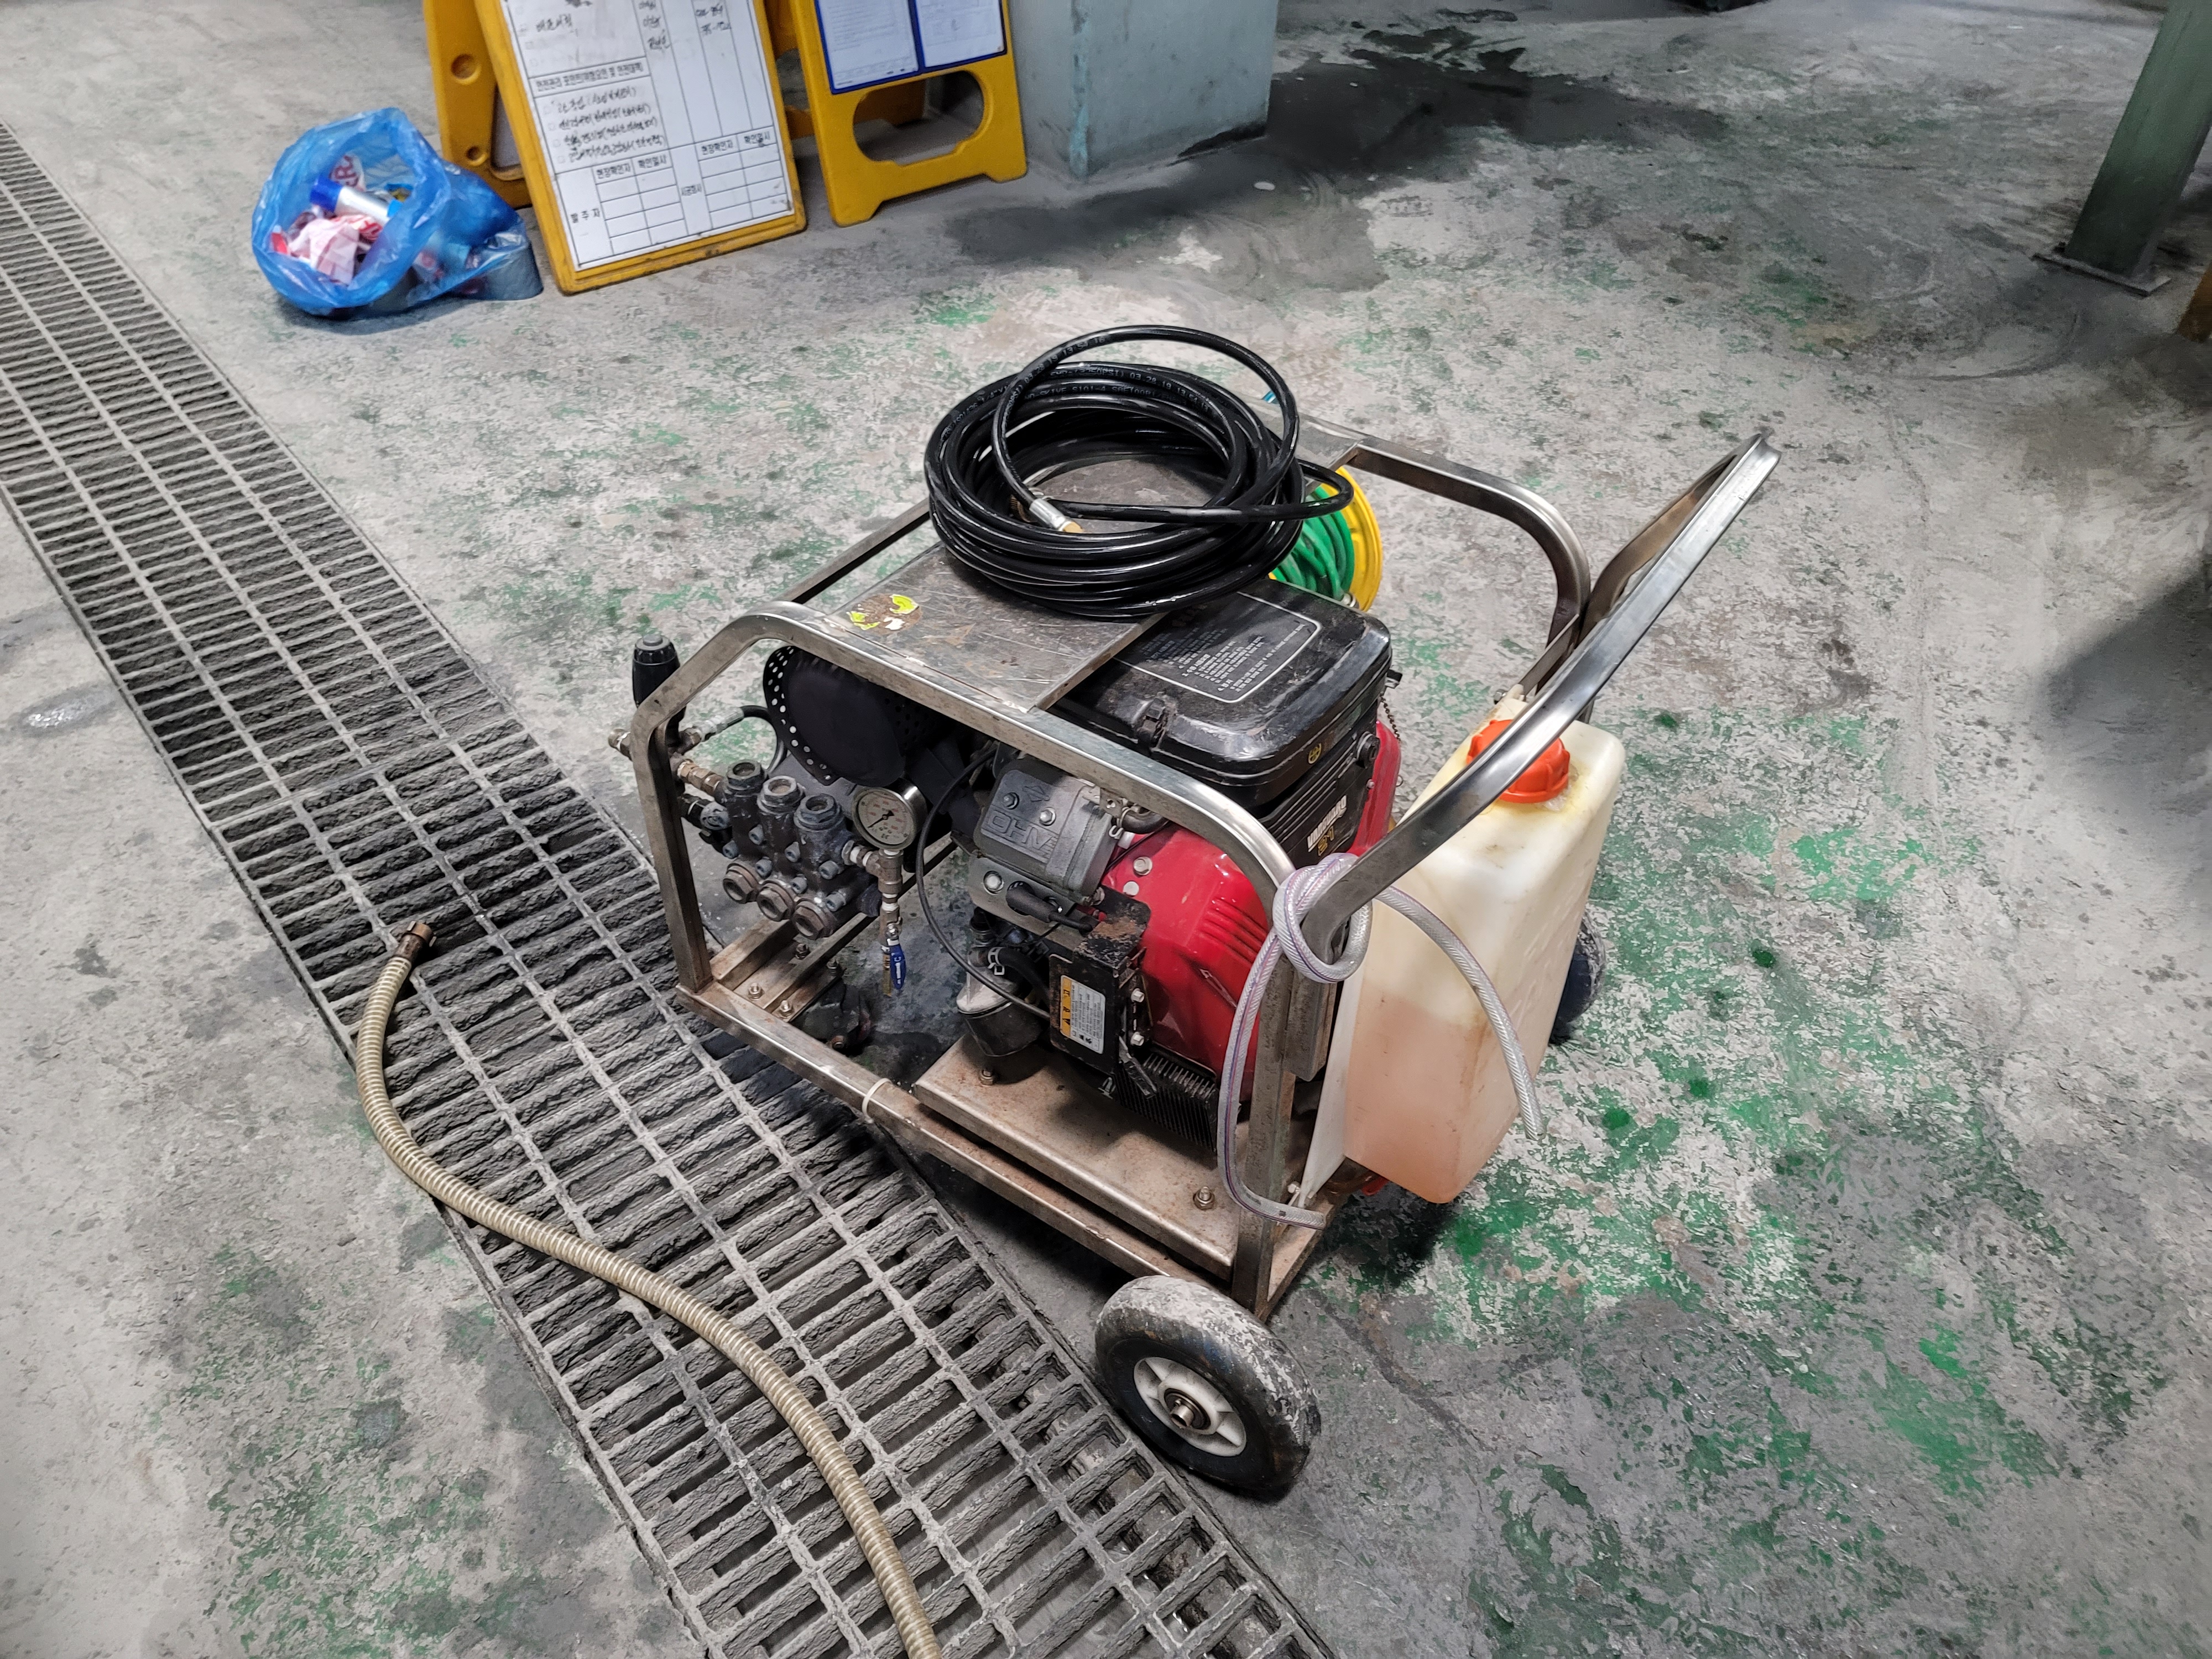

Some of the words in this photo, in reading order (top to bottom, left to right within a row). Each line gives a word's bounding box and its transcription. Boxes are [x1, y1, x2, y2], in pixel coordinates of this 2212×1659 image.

[701, 139, 734, 155] 현장확인자
[597, 163, 631, 179] 현장확인자
[638, 155, 667, 169] 확인일시
[985, 808, 1053, 854] OHV
